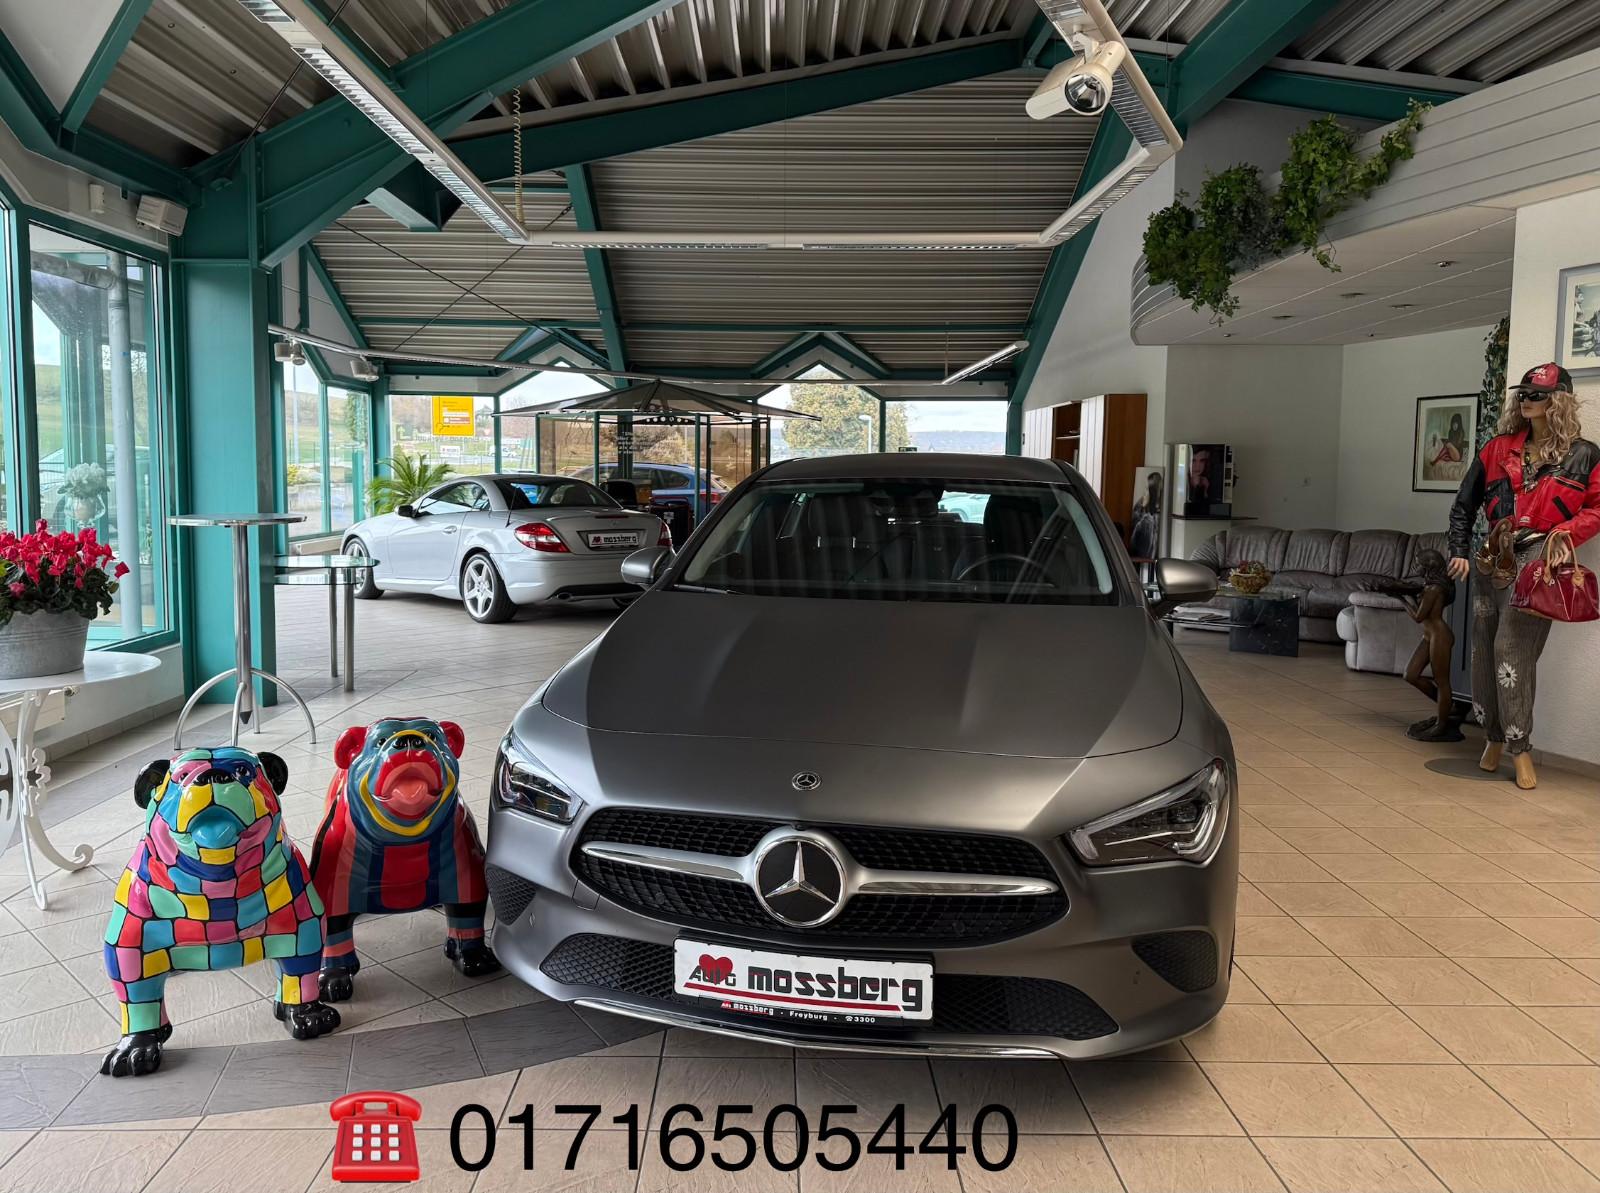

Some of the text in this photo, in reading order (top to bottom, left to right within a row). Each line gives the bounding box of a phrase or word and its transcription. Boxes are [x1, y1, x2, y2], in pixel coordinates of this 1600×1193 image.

[747, 965, 923, 1012] mossberg
[733, 1003, 774, 1016] mossberg
[789, 1010, 828, 1021] Freyburg
